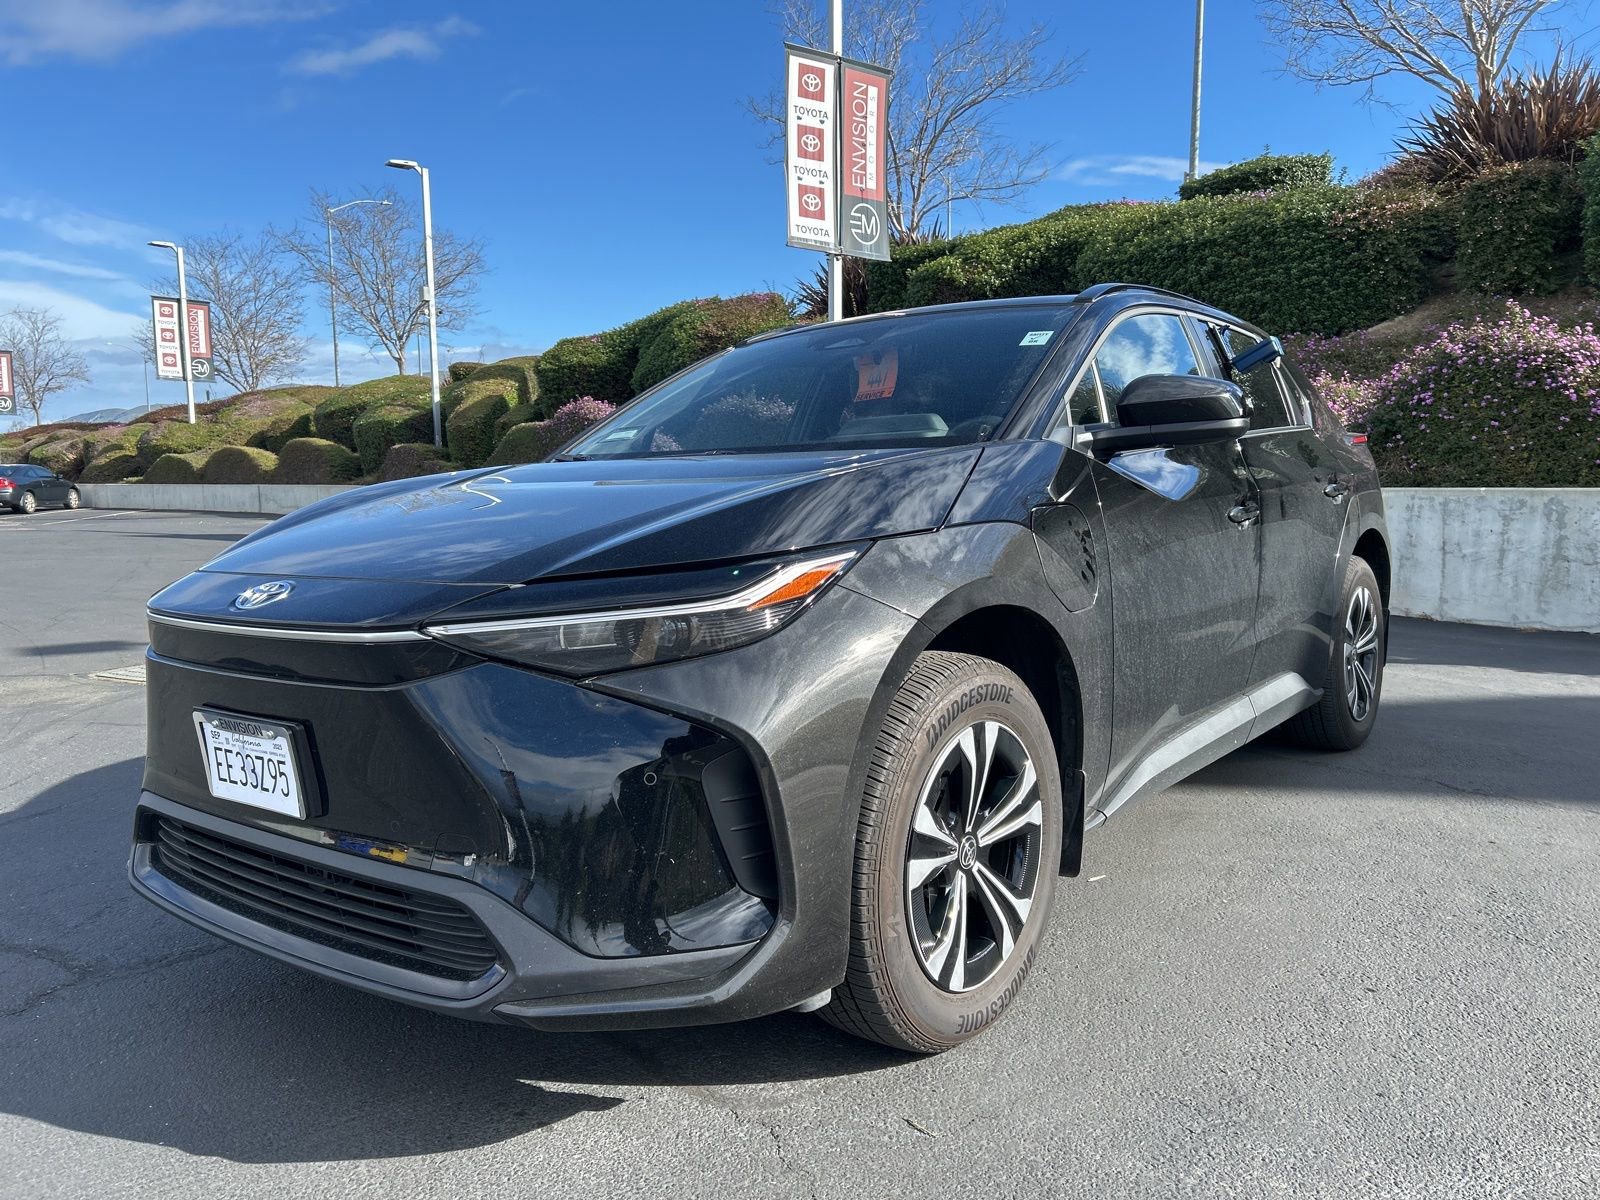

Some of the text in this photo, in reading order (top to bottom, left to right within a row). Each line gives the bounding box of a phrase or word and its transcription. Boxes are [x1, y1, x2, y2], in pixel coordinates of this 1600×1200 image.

[793, 105, 829, 121] TOYOTA
[852, 81, 867, 188] ENVISION
[868, 96, 876, 181] MOTORS
[793, 165, 829, 180] TOYOTA
[795, 224, 830, 238] TOYOTA
[189, 308, 199, 353] ENVISION
[218, 718, 263, 737] ENVISION
[925, 683, 1014, 753] BRIDGESTONE
[214, 746, 289, 797] EE33Z95
[955, 944, 1035, 1034] BRIDGESTONE
